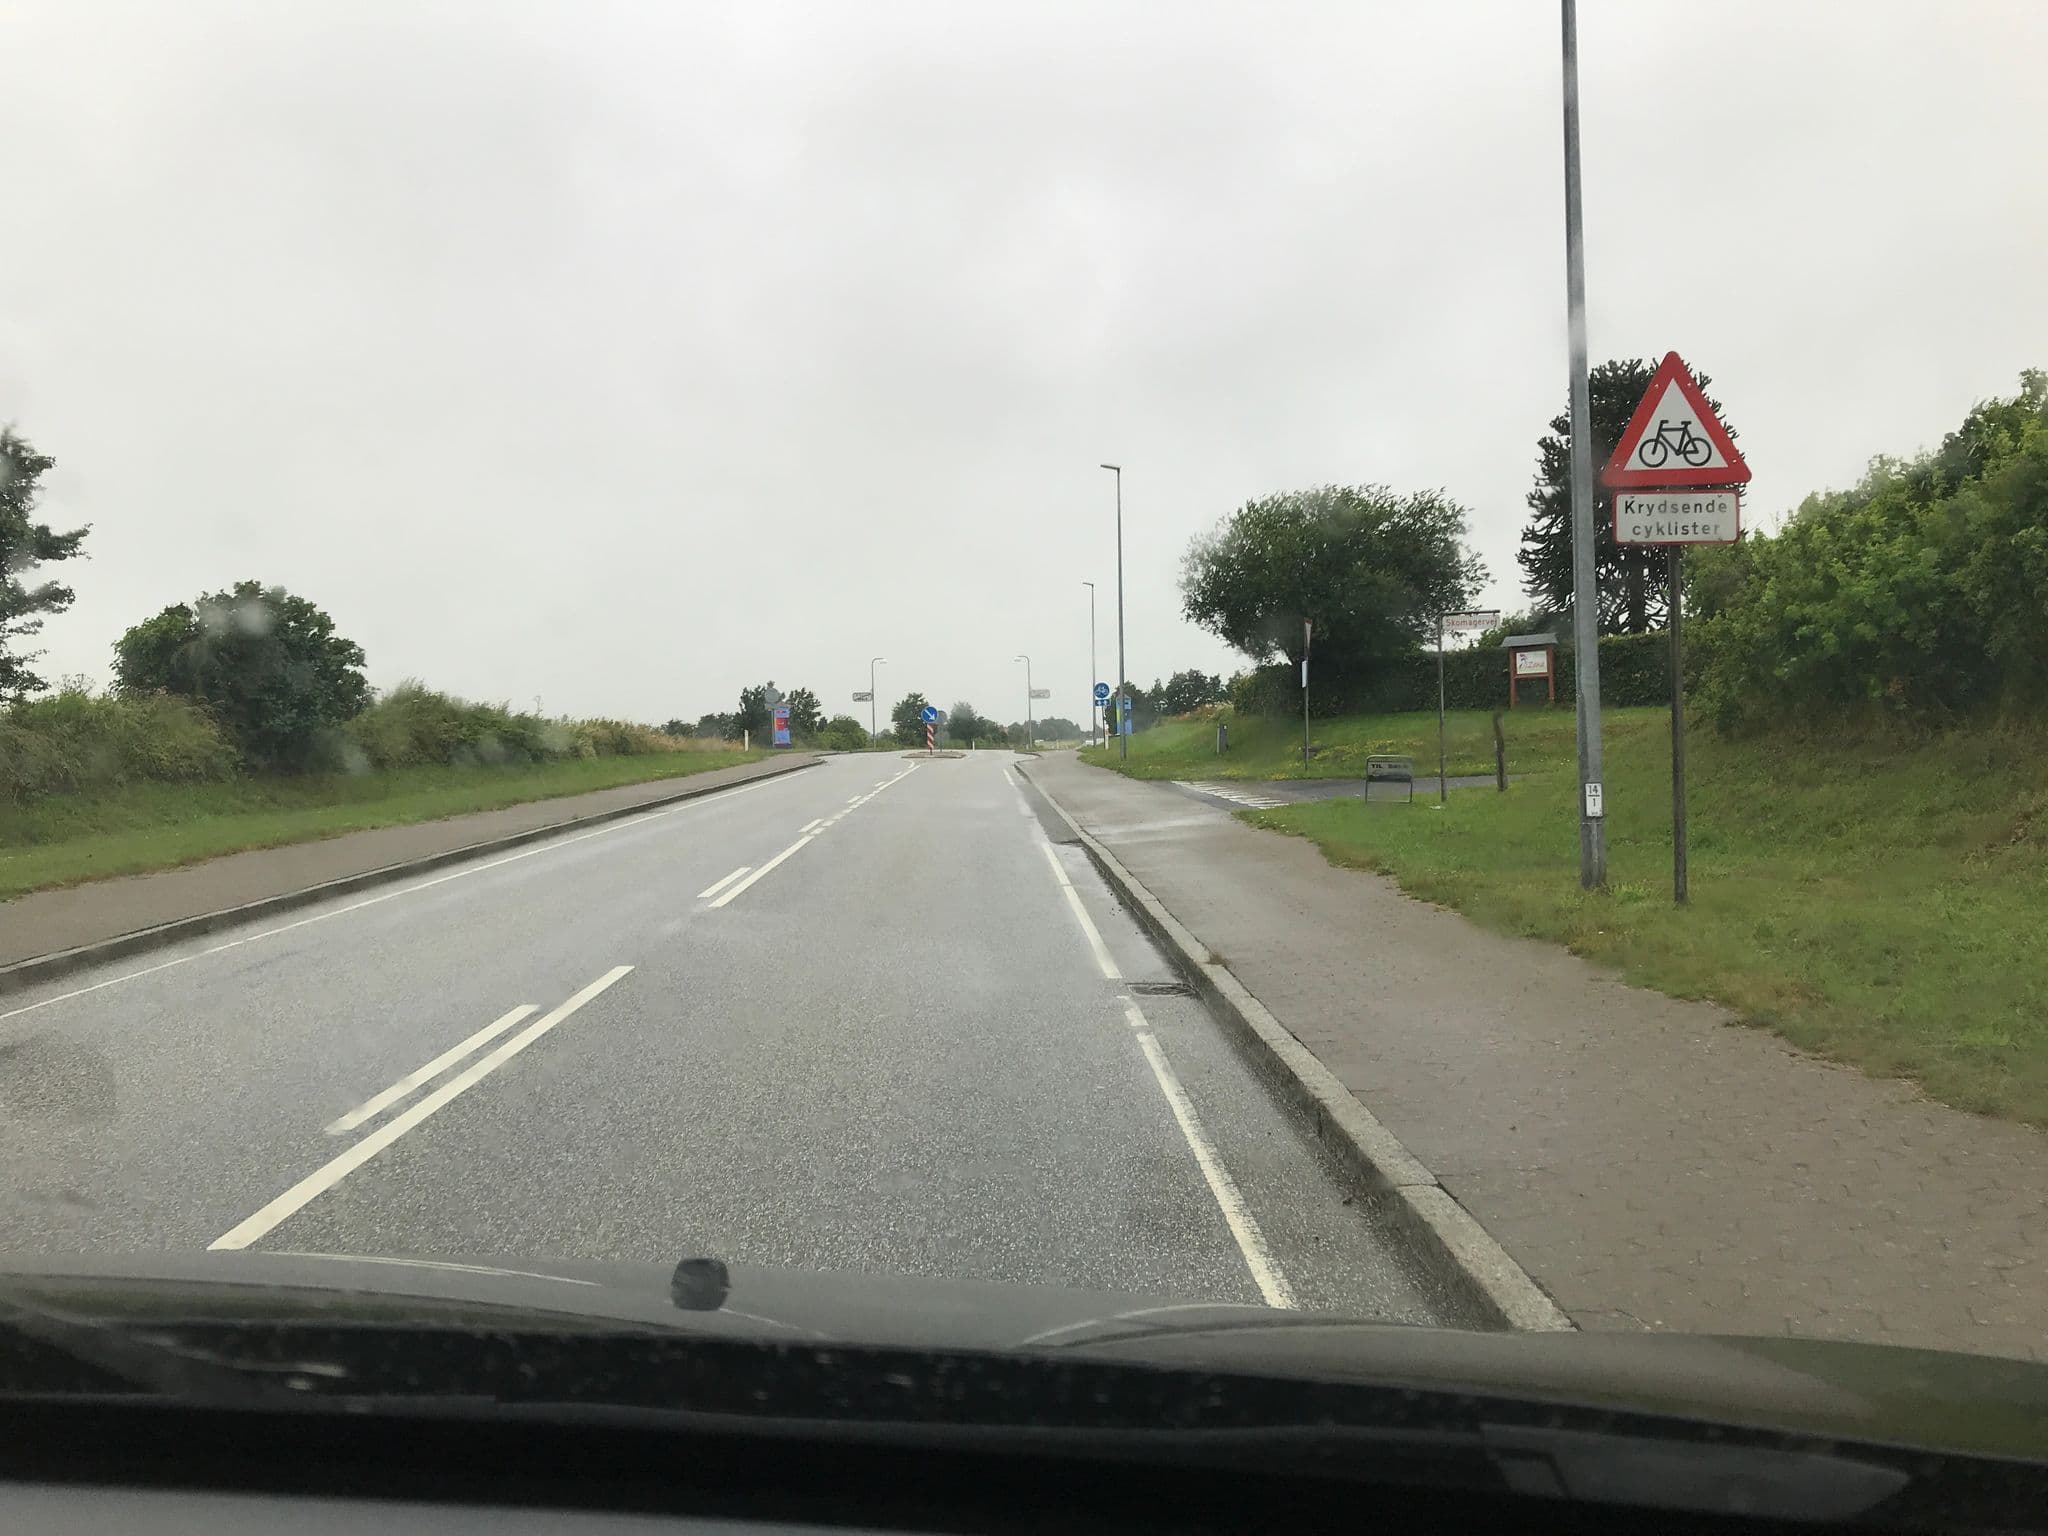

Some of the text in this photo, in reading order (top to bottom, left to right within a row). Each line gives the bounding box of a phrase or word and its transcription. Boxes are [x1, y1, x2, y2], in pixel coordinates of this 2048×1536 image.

[1624, 499, 1727, 516] Krydsende
[1632, 521, 1720, 538] cyklister
[1446, 618, 1498, 629] Skomagervej
[1588, 785, 1598, 794] 14
